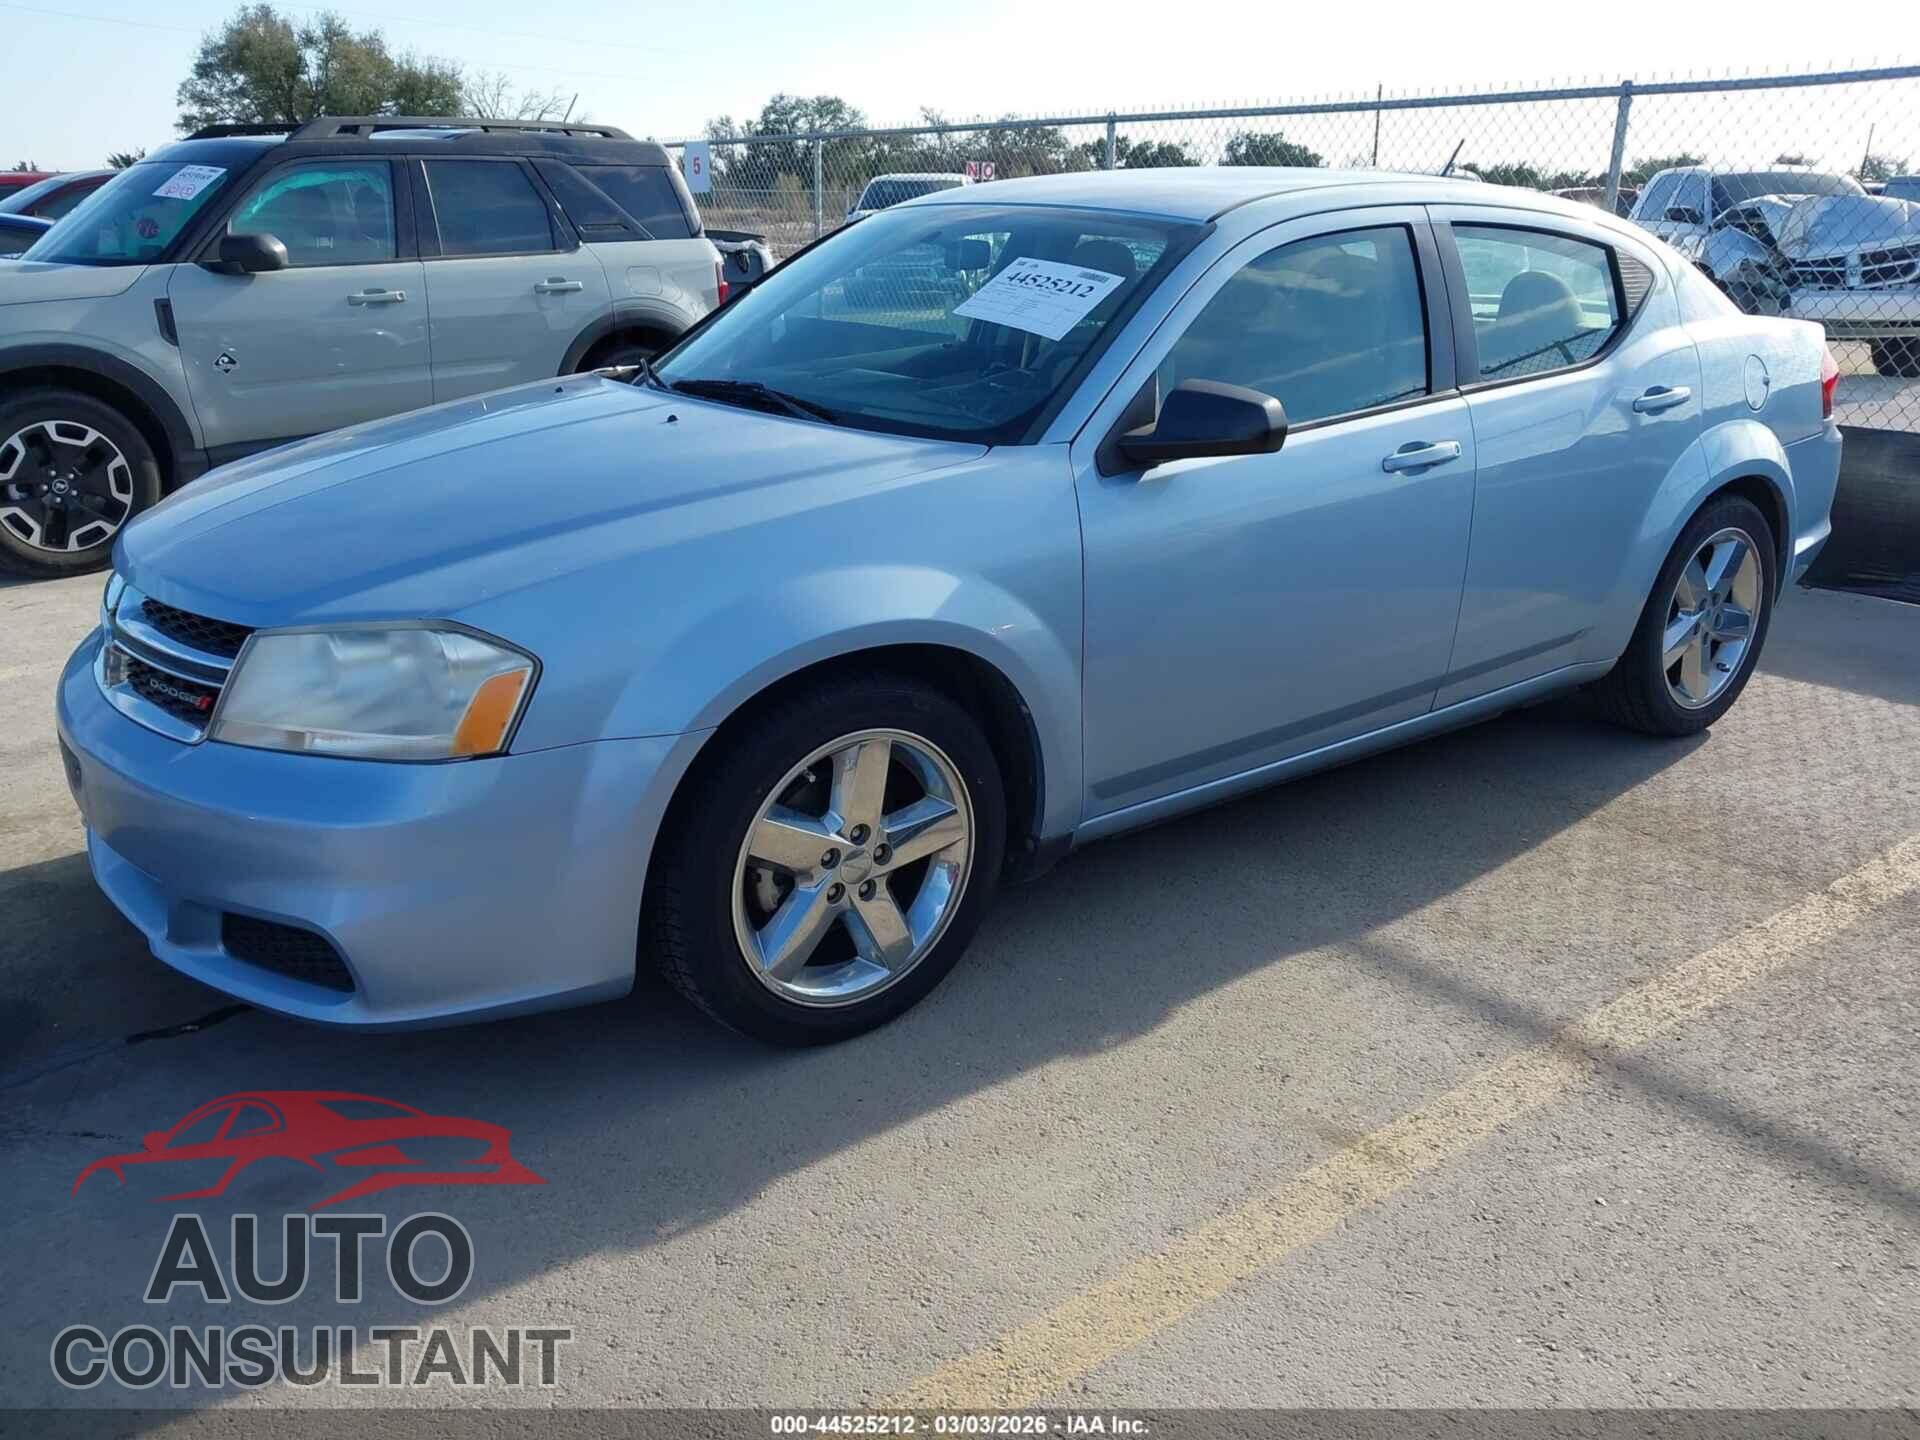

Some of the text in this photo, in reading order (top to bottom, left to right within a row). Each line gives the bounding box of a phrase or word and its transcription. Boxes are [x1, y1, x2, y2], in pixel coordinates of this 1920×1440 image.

[692, 156, 701, 175] 5
[967, 163, 993, 178] NO
[1007, 271, 1095, 298] 44525212
